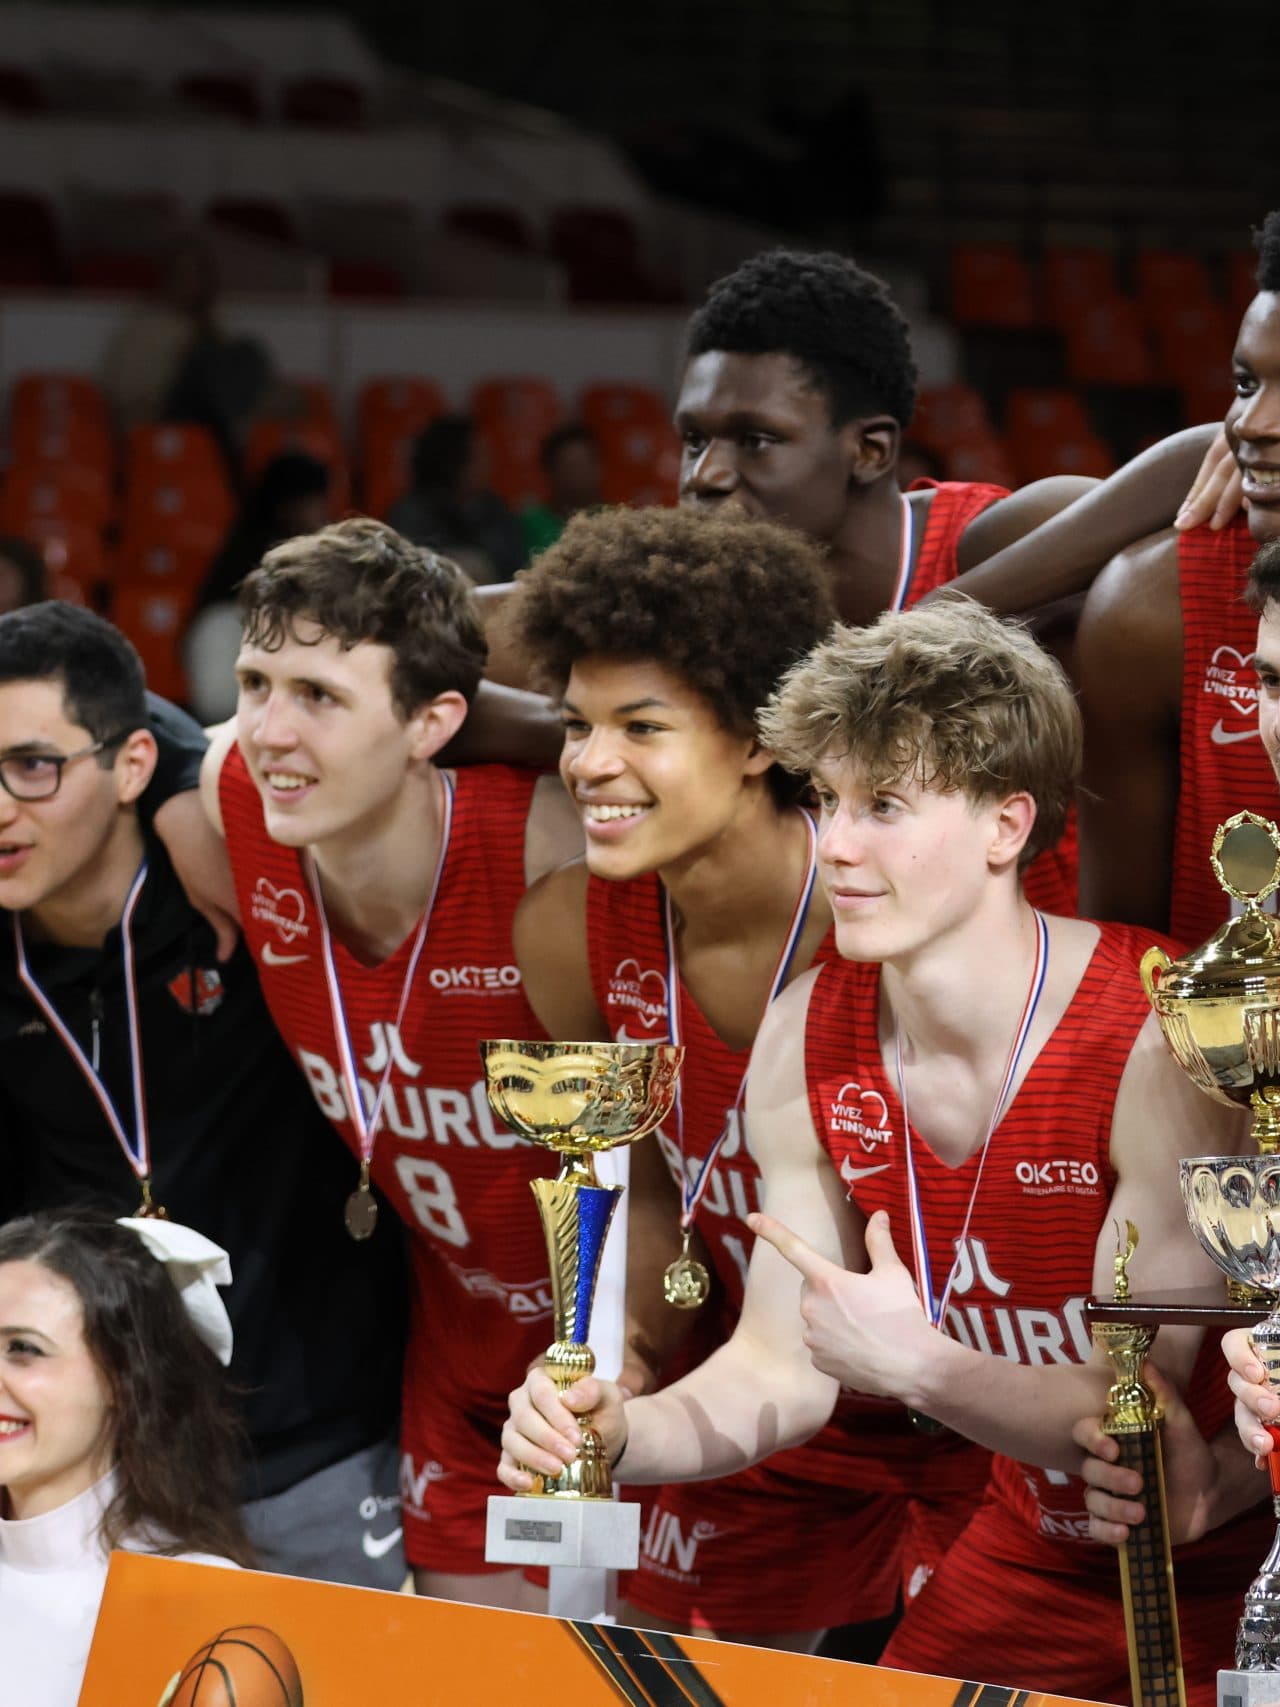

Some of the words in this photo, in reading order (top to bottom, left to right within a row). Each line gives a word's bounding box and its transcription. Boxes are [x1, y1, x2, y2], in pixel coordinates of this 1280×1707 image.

[1204, 680, 1260, 699] L'INSTA
[429, 965, 522, 989] OKTEO
[830, 1102, 864, 1121] VIVEZ
[1015, 1160, 1099, 1186] OKTEO
[395, 1155, 471, 1248] 8
